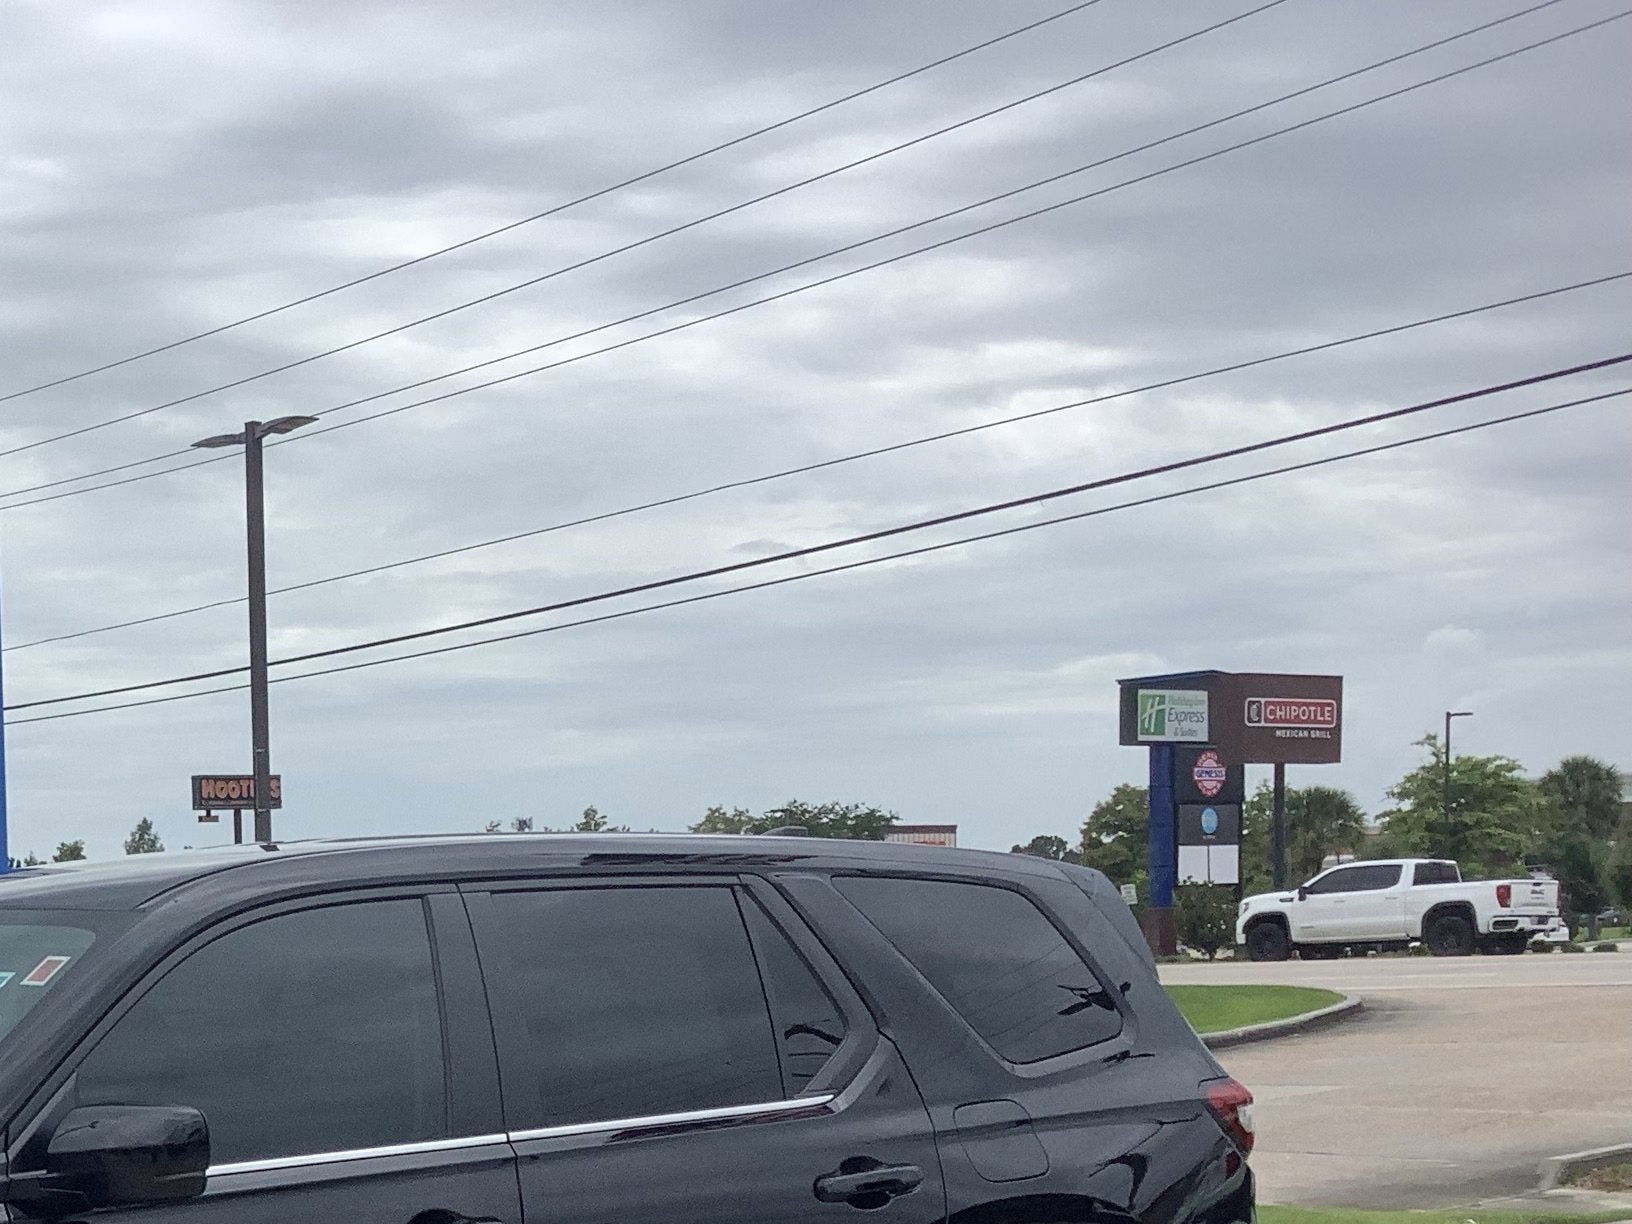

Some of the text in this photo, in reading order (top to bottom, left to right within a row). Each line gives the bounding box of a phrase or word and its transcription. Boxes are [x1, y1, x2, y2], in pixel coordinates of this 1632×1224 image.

[1168, 707, 1205, 726] Express
[1266, 704, 1332, 721] CHIPOTLE
[1180, 727, 1198, 737] Suites
[1275, 729, 1331, 739] MEXICAN GRILL
[201, 778, 280, 799] HOOTS
